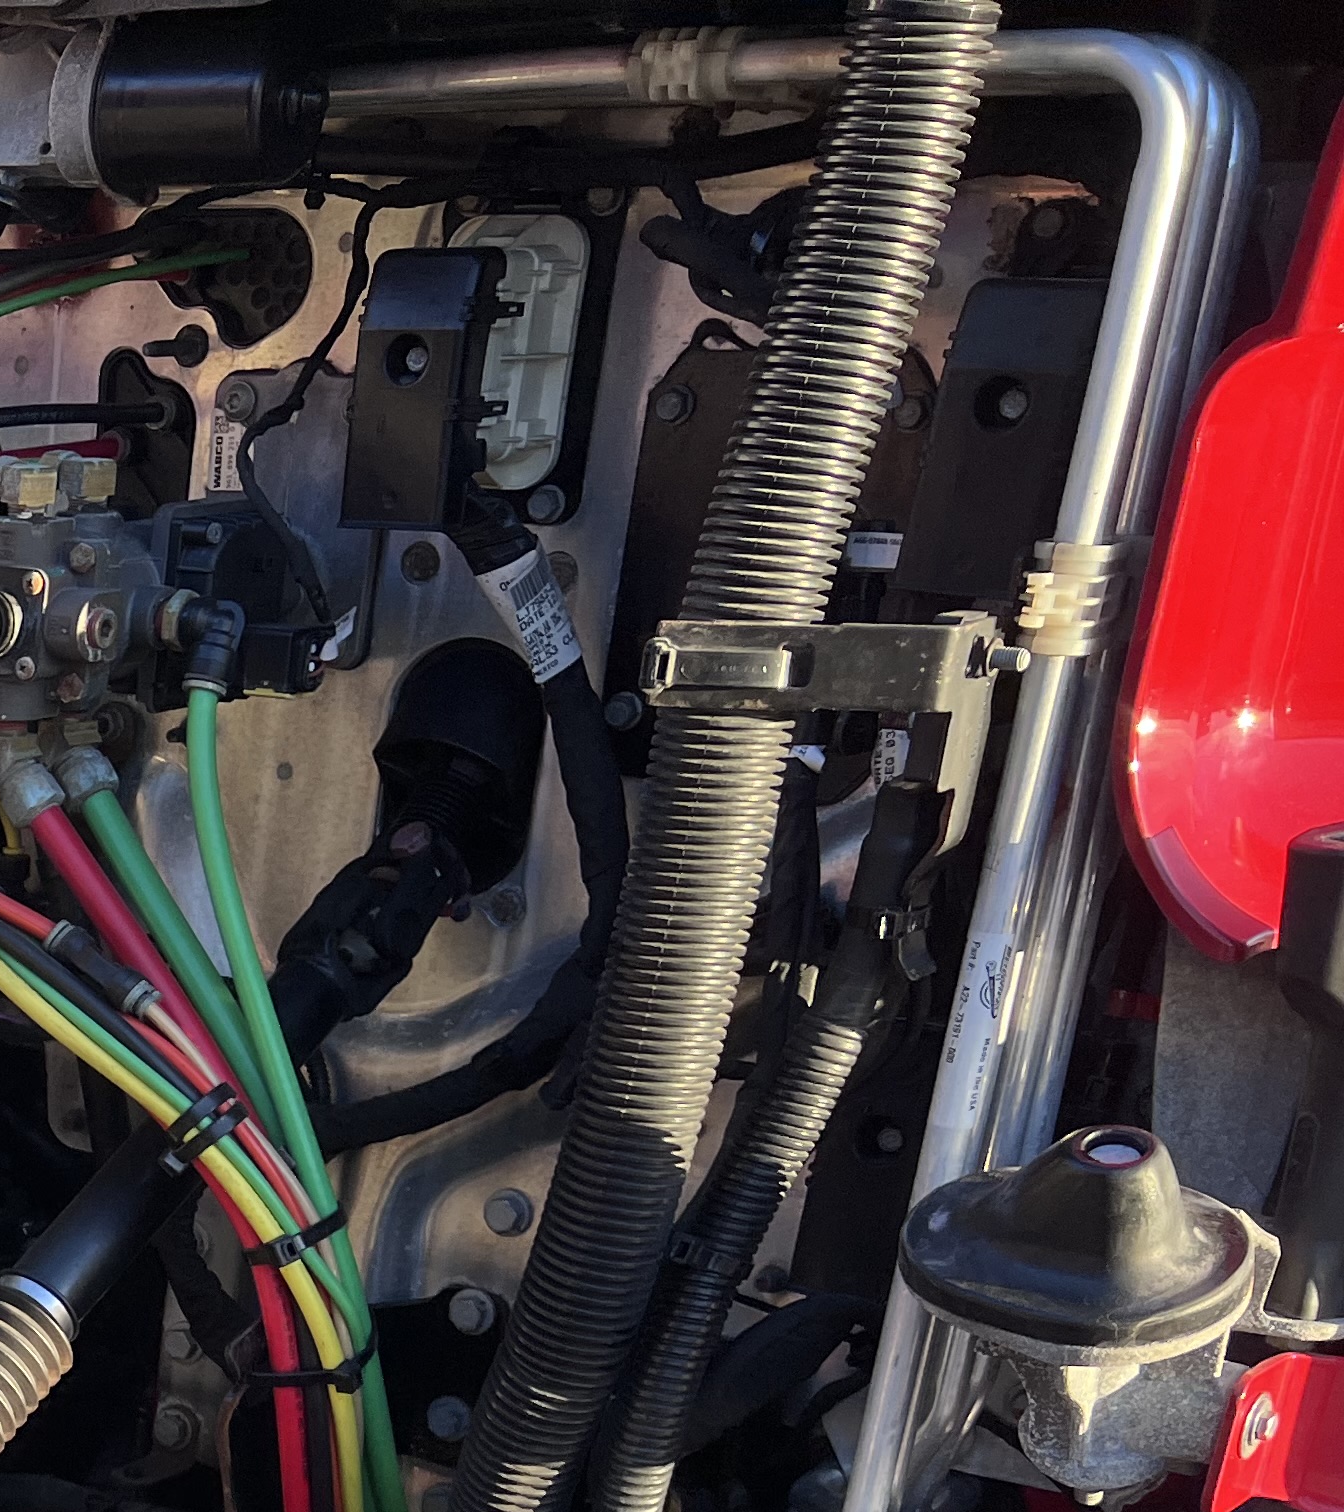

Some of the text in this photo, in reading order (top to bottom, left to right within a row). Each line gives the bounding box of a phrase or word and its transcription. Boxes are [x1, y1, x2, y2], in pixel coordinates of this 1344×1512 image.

[213, 436, 224, 489] WABCO
[967, 941, 981, 960] Part
[968, 1093, 979, 1112] USA
